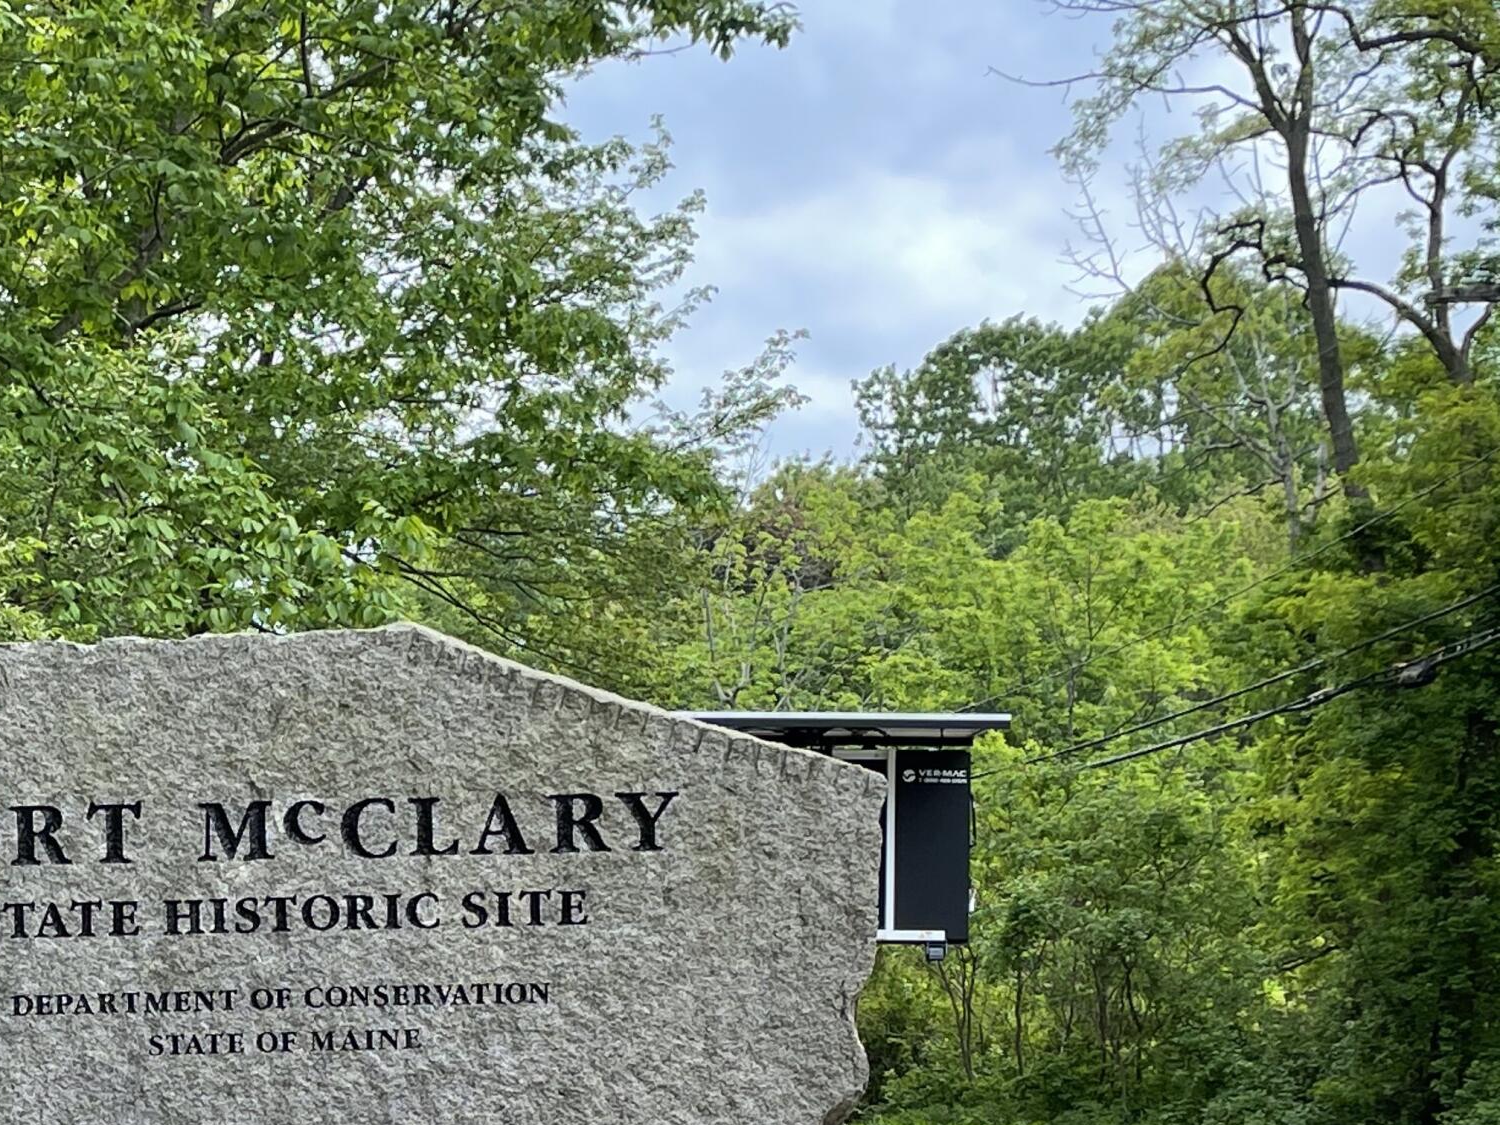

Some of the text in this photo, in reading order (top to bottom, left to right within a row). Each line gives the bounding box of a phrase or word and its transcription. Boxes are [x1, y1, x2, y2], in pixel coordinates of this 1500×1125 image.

[165, 892, 442, 936] HISTORIC
[461, 889, 590, 929] SITE
[11, 982, 551, 1017] DEPARTMENT OF CONSERVATION
[148, 1028, 422, 1056] STATE OF MAINE
